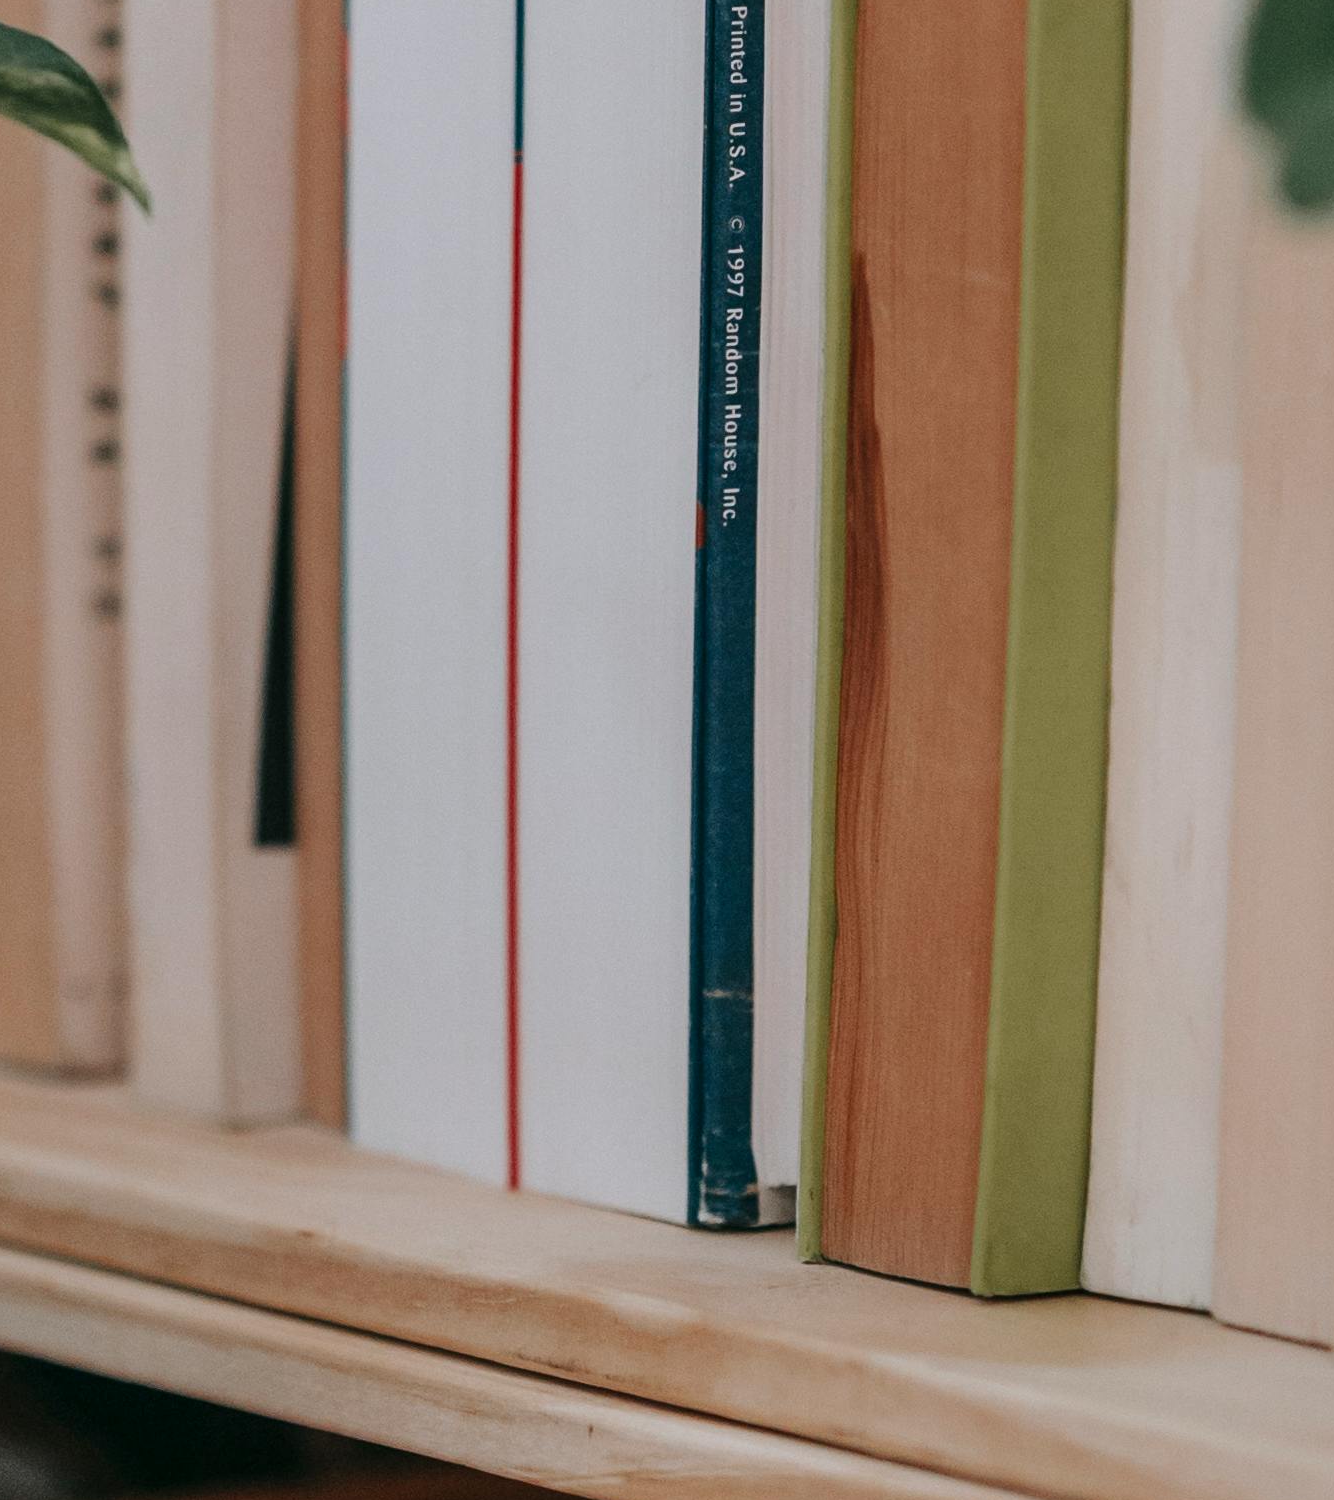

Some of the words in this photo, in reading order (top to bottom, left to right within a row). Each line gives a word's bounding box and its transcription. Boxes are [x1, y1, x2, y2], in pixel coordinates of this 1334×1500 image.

[730, 6, 748, 84] Printed
[729, 94, 747, 113] in
[729, 122, 746, 188] U.S.A.
[727, 245, 745, 297] 1997
[725, 308, 744, 395] Random
[721, 404, 742, 479] House,
[722, 488, 740, 527] Inc.
